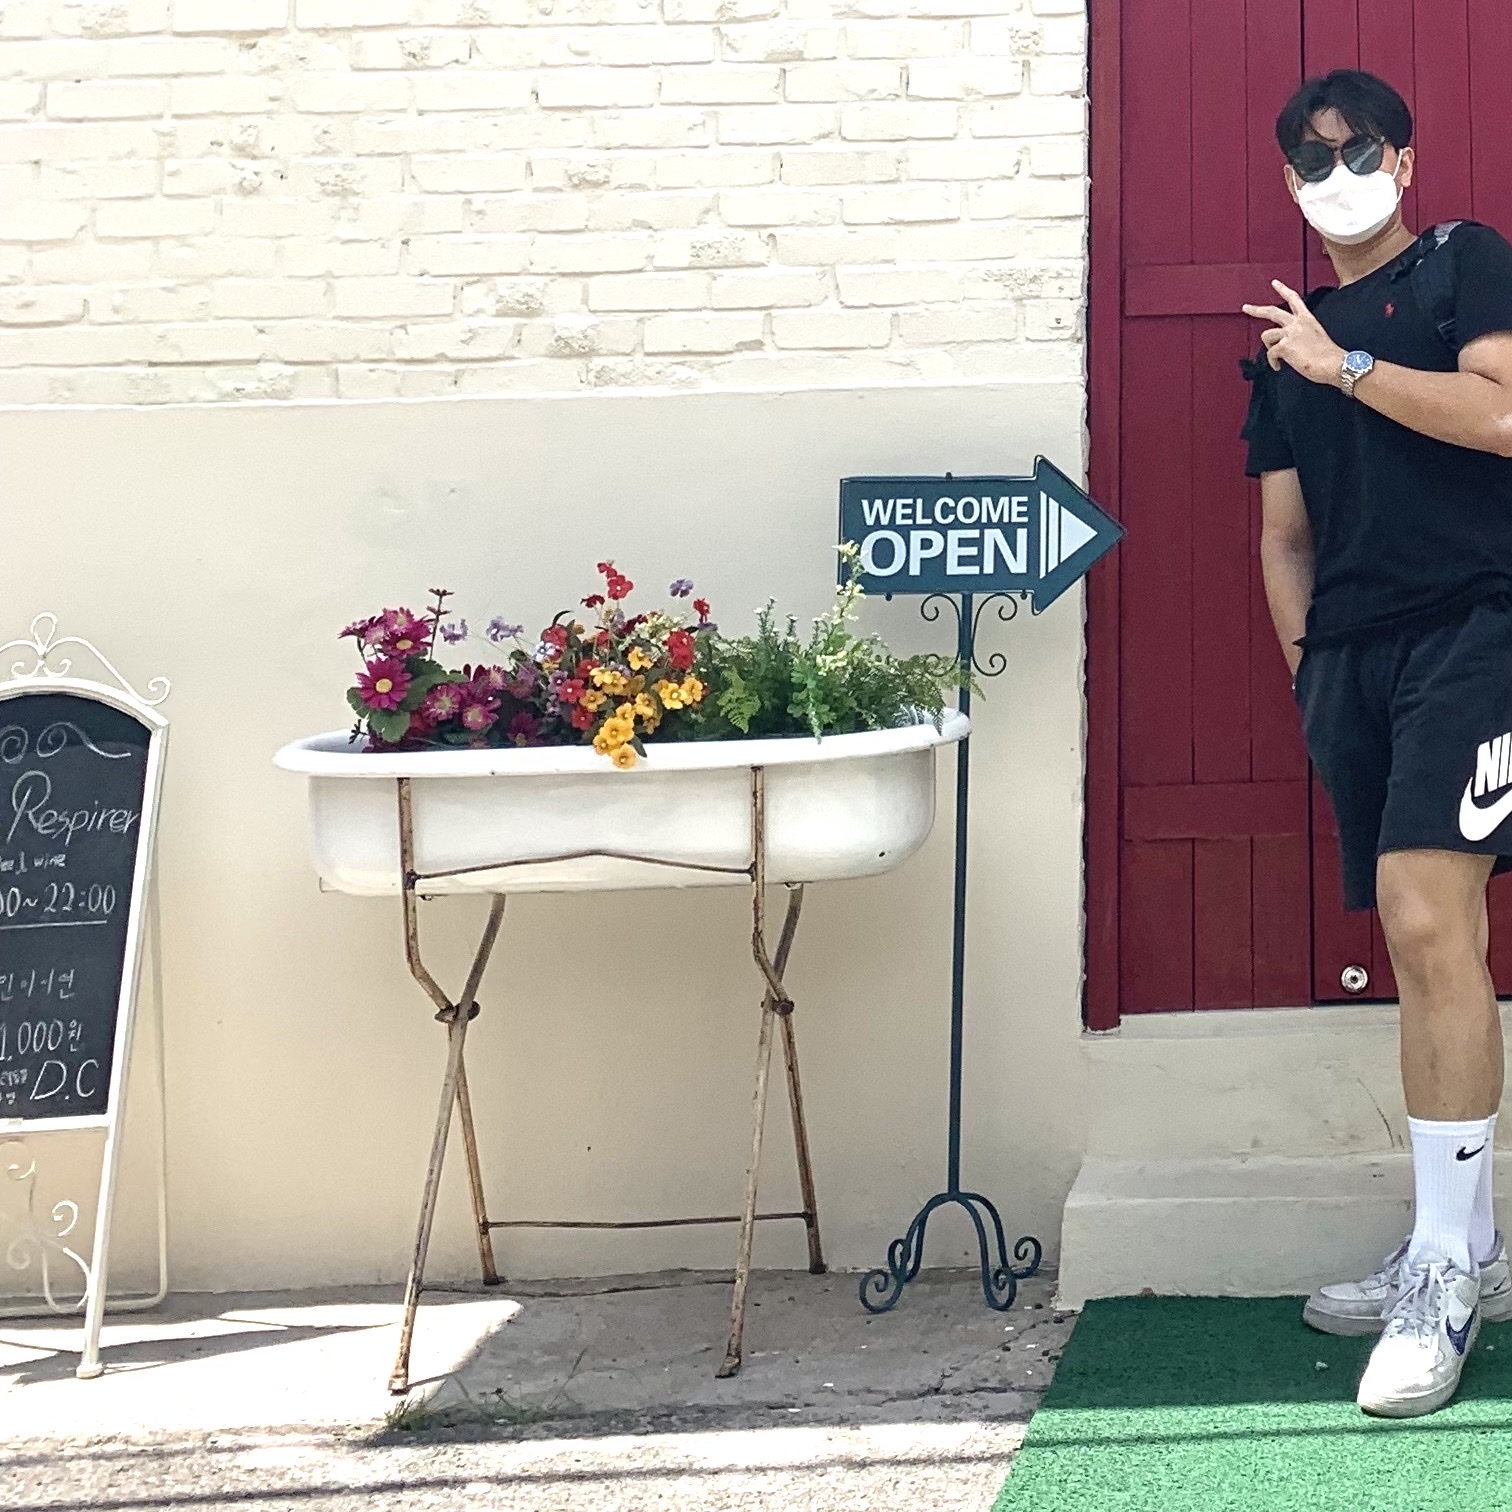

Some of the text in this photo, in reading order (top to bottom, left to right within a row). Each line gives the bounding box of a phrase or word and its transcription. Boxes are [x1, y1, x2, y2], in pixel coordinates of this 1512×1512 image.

[861, 495, 1029, 526] WELCOME
[860, 527, 1028, 577] OPEN
[7, 769, 139, 847] Respirer
